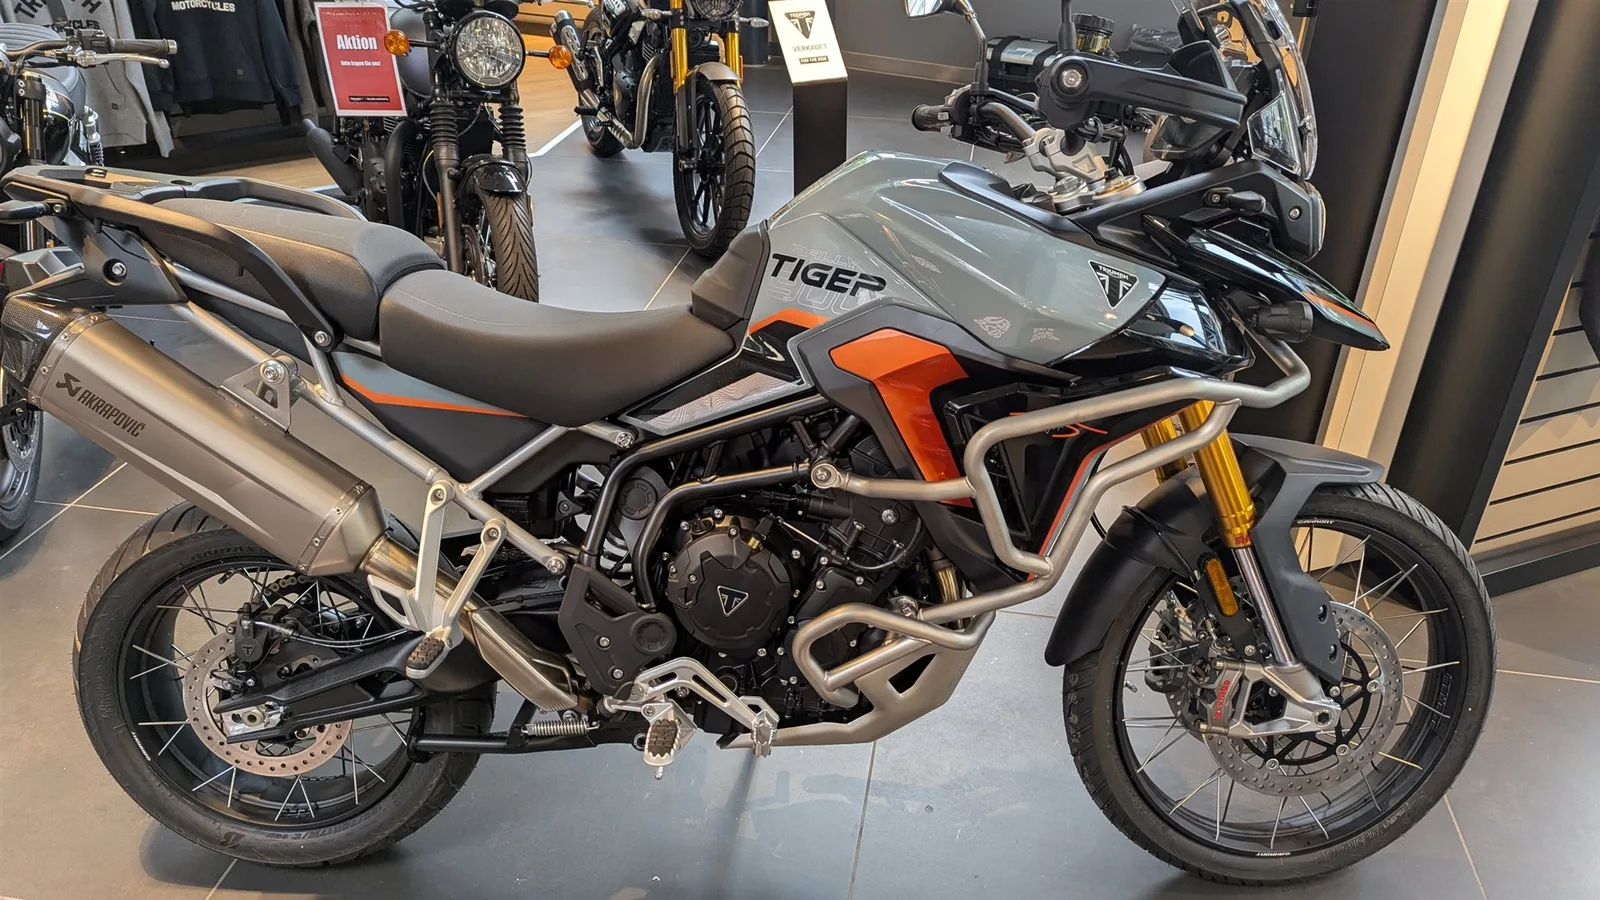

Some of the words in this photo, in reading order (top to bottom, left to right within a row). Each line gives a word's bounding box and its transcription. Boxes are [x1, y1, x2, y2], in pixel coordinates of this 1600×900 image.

[171, 0, 236, 12] MOTORCYCLES
[336, 34, 378, 50] Aktion
[792, 44, 828, 52] VERKAUFT
[789, 243, 860, 270] RALLY
[771, 253, 887, 297] TIGER
[1098, 265, 1129, 280] TRIUMPH
